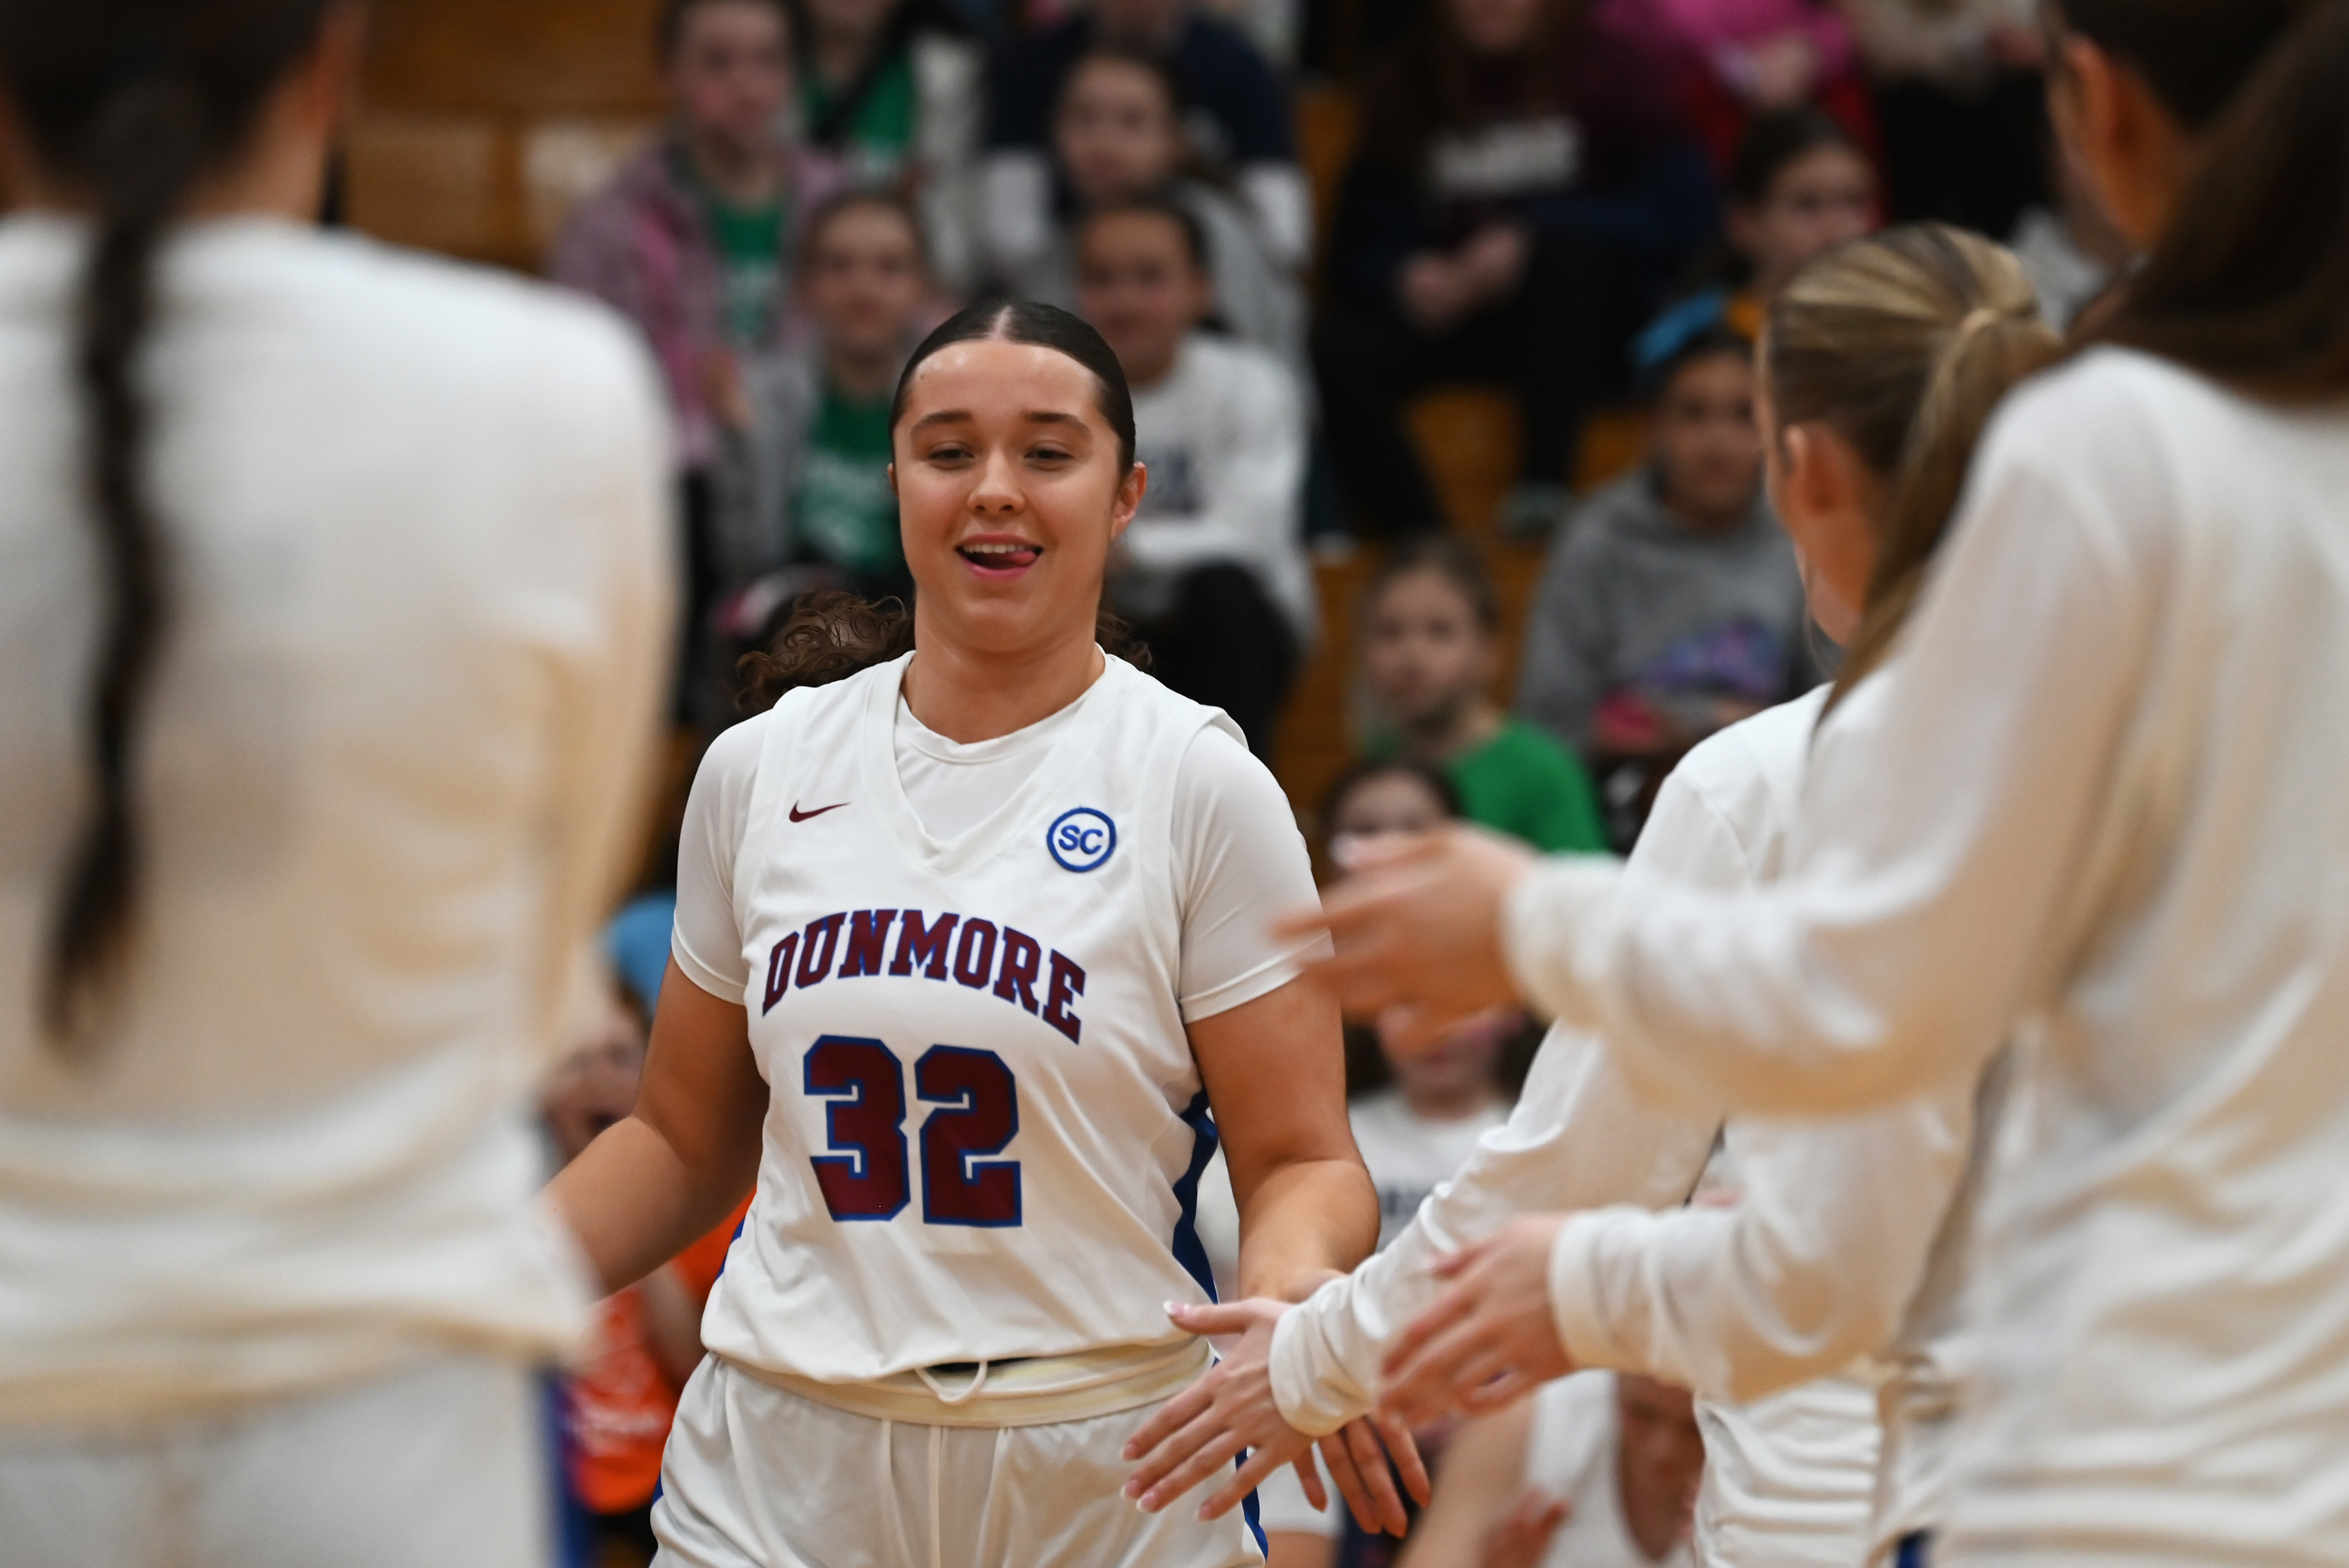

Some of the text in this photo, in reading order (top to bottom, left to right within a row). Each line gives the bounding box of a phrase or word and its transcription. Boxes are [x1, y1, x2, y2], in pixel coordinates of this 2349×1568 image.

[1059, 825, 1102, 855] SC
[763, 909, 1086, 1045] DUNMORE
[803, 1034, 1022, 1227] 32
